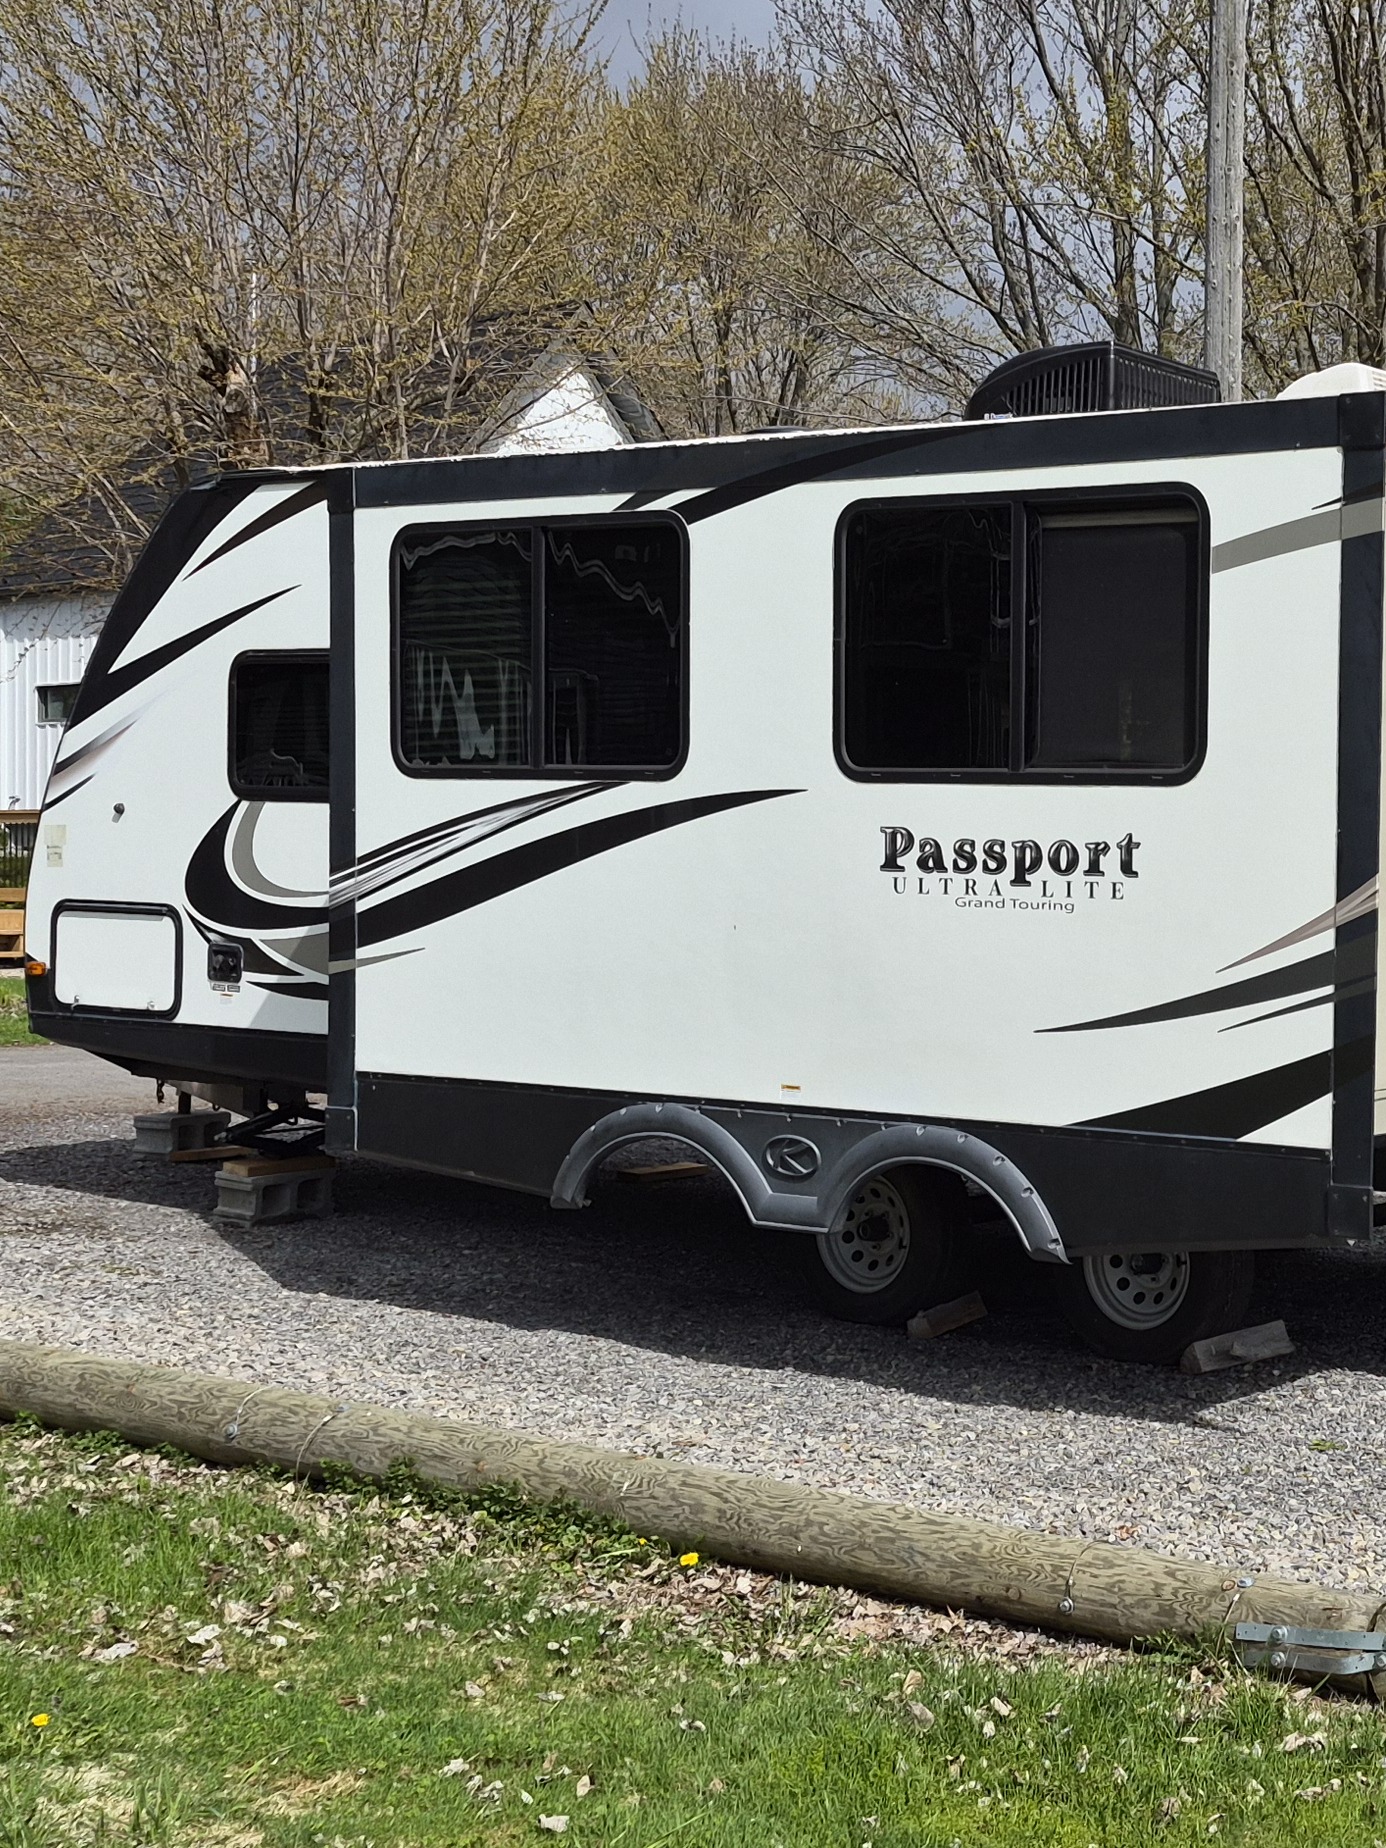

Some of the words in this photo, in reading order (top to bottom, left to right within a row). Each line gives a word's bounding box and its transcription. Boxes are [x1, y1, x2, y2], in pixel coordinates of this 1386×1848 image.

[879, 825, 1141, 887] Passport
[891, 876, 1002, 896] ULTRA
[1041, 880, 1124, 900] LITE
[955, 897, 1005, 909] Grand
[1009, 898, 1075, 914] Touring
